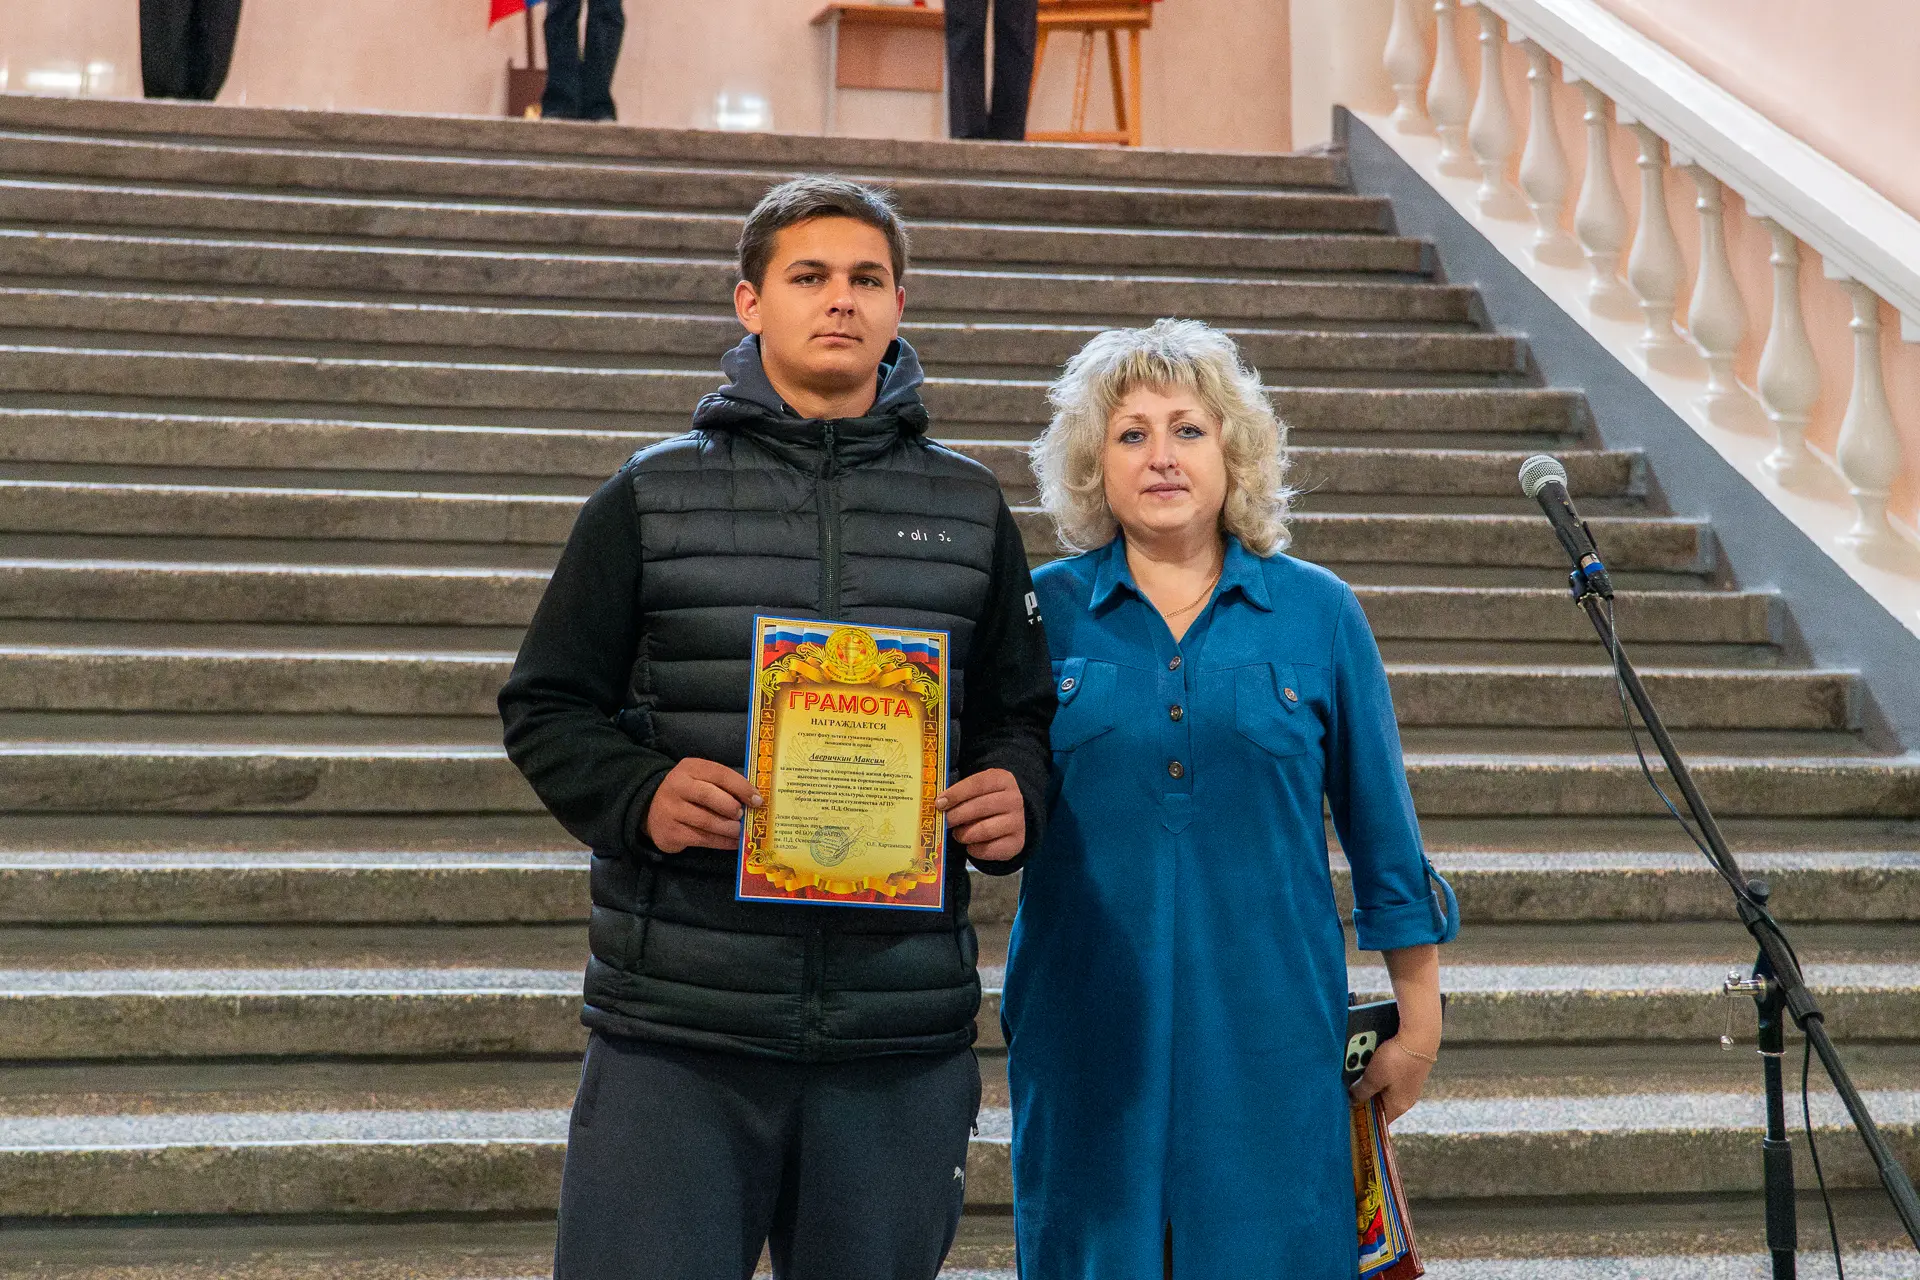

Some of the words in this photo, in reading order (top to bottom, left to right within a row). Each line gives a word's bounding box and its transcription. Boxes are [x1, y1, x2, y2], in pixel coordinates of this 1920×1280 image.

[789, 690, 913, 718] ГРАМОТА
[811, 718, 887, 731] НАГРАЖДАЕТСЯ
[853, 755, 886, 765] Максим
